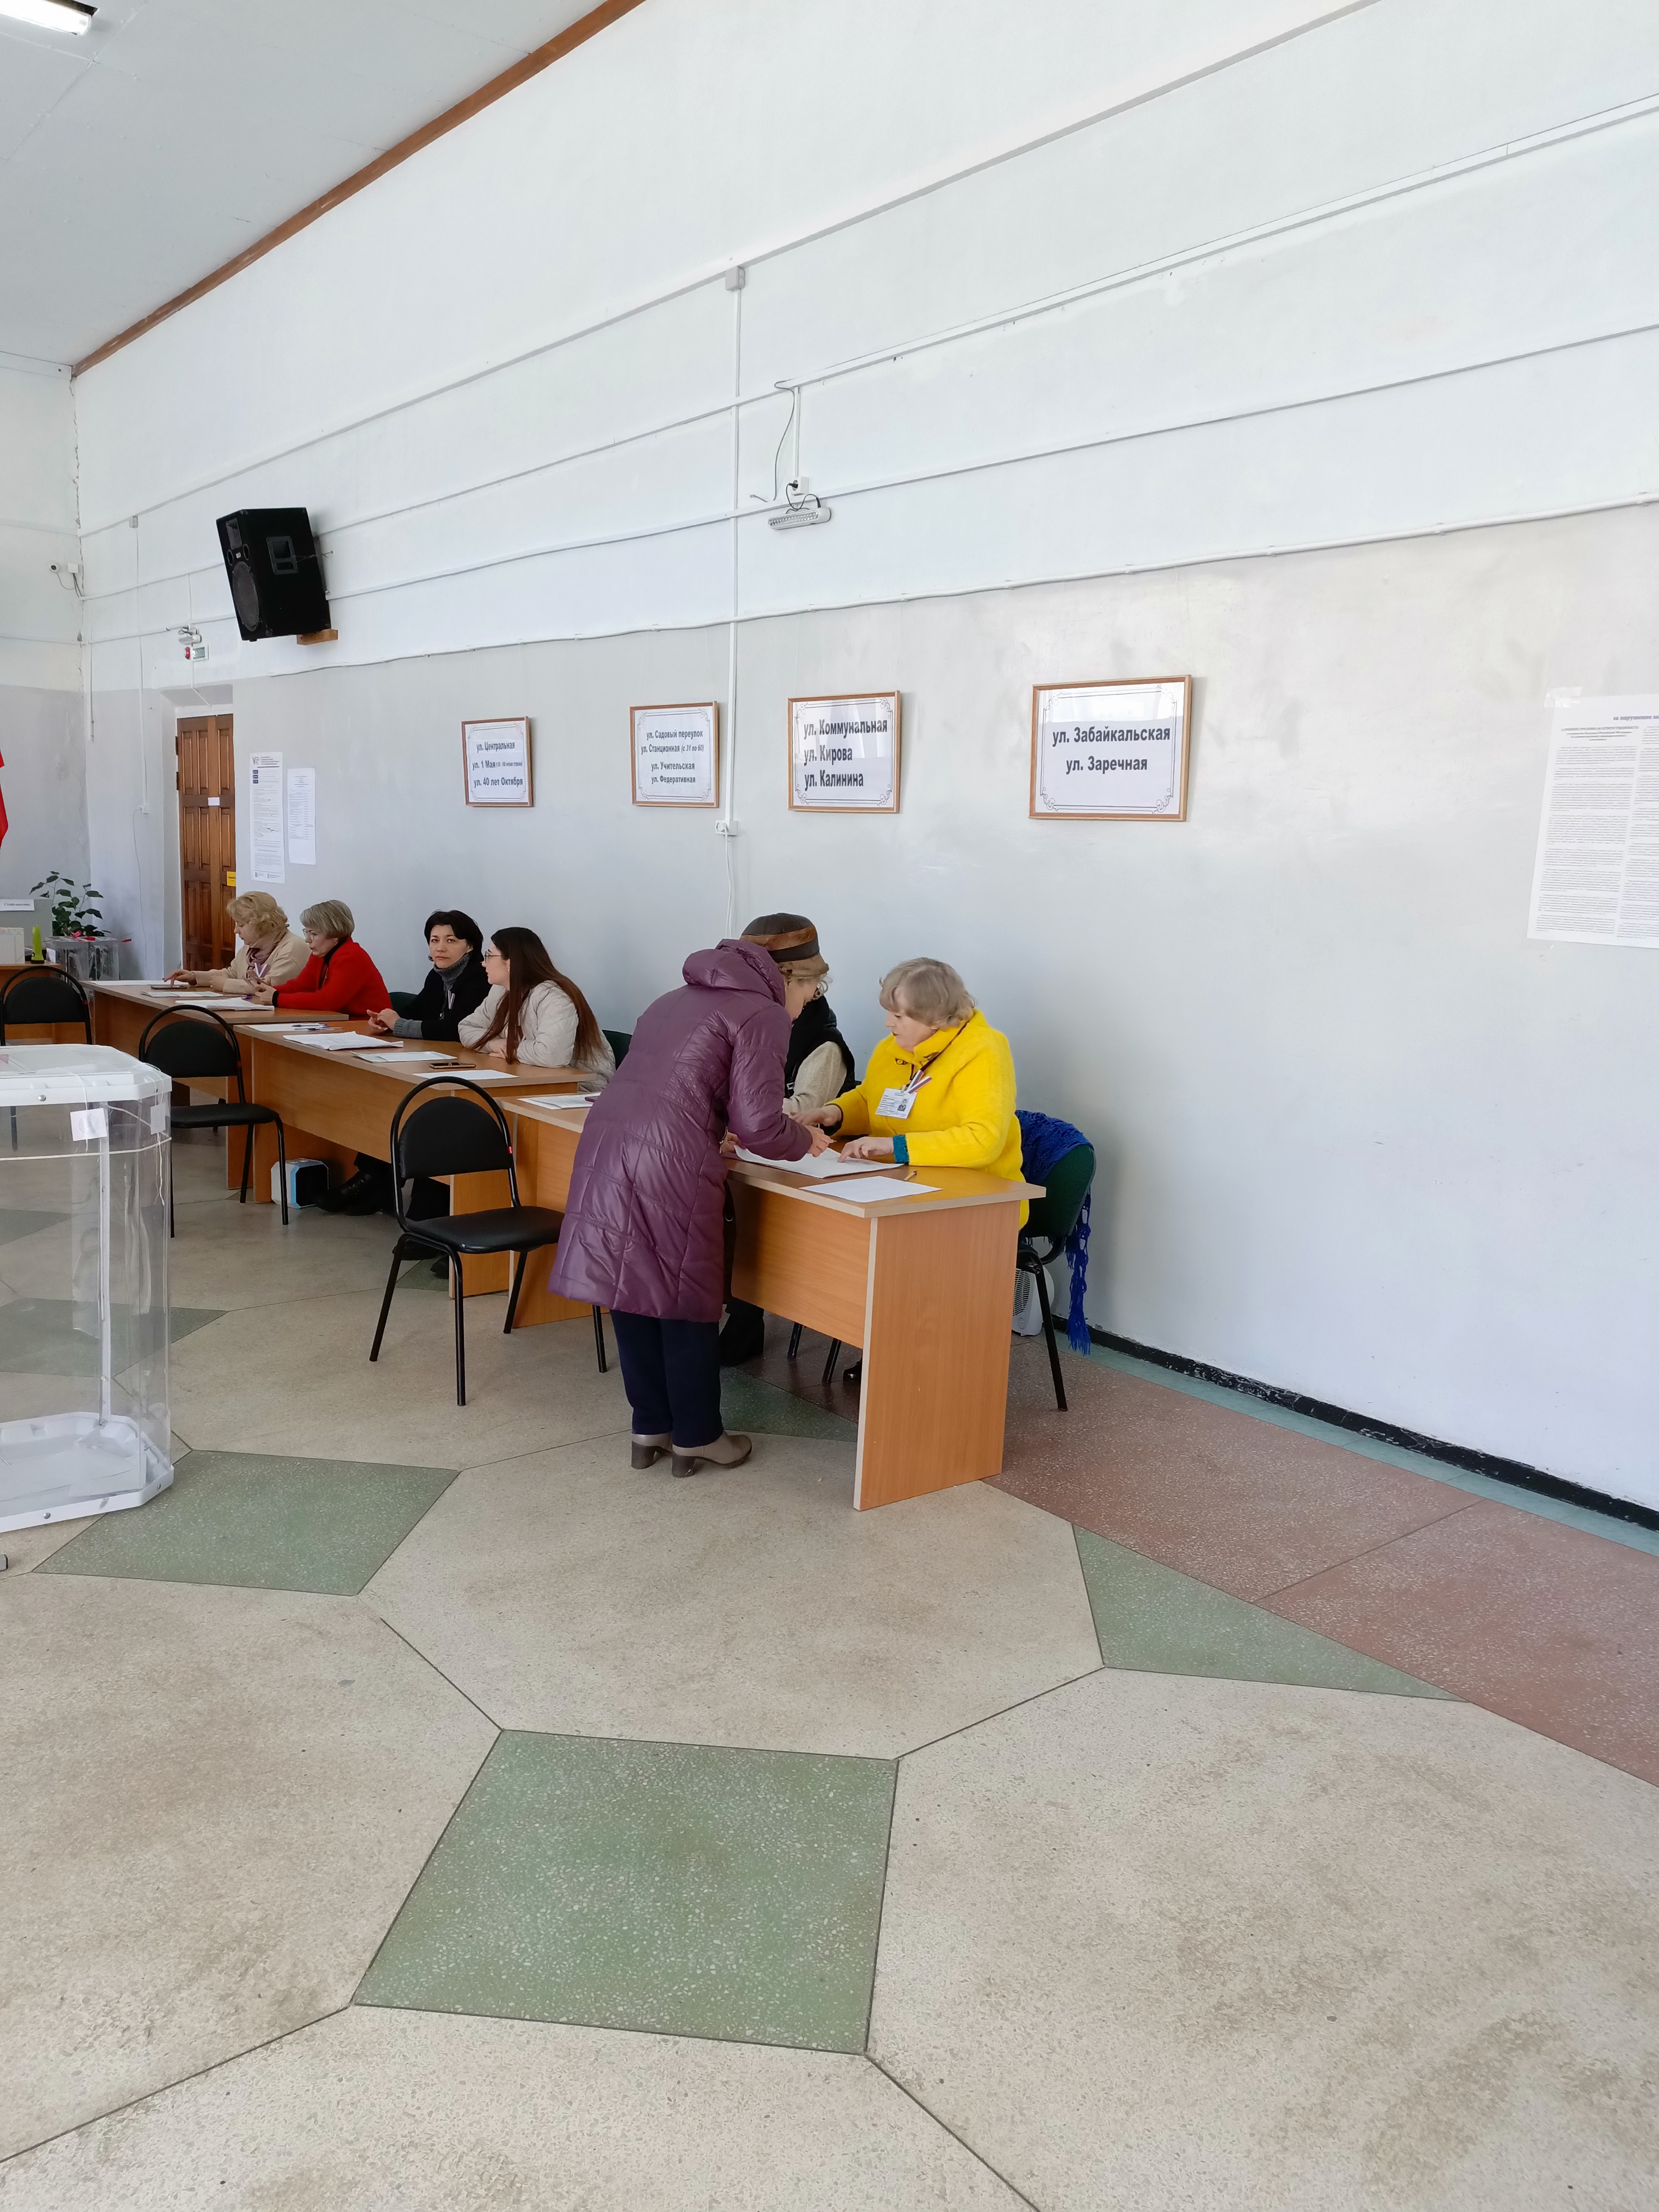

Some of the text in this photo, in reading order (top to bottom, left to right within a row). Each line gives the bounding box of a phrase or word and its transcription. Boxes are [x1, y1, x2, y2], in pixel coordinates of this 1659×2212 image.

[804, 719, 887, 740] ул. Коммунальная
[655, 730, 677, 739] Садовый
[679, 731, 703, 740] переулок
[1052, 726, 1170, 747] ул. Забайкальская
[485, 742, 515, 752] Центральная
[649, 744, 679, 753] Станционная
[804, 745, 853, 766] ул. Кирова
[661, 761, 695, 769] Учительская
[1066, 756, 1147, 774] ул. Заречная
[501, 777, 523, 787] Октября
[660, 775, 695, 784] Федеративная
[805, 770, 864, 791] ул. Калинина
